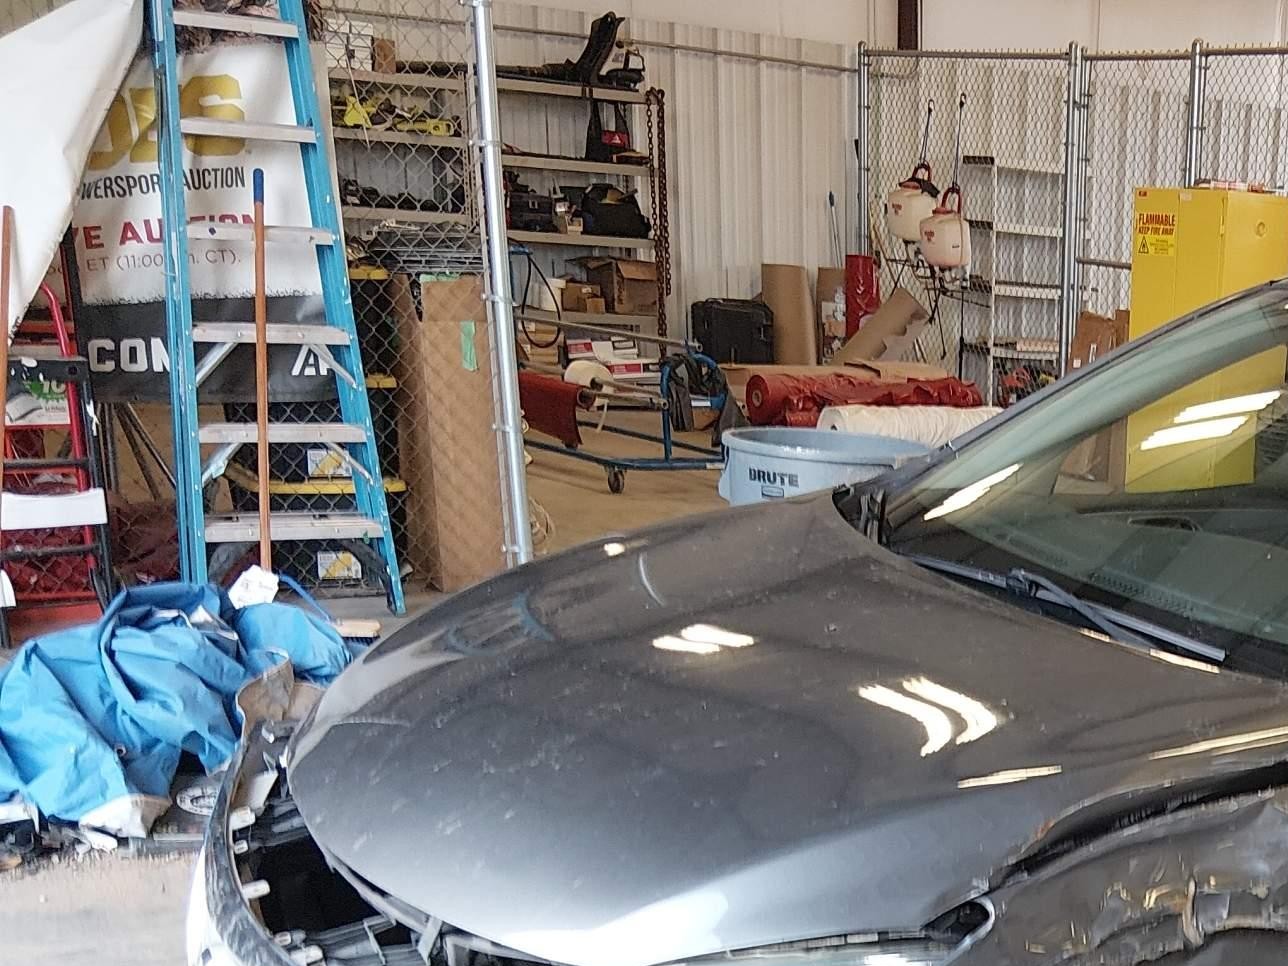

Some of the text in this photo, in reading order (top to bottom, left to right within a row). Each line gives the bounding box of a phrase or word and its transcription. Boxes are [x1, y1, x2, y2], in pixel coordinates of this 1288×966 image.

[183, 165, 246, 193] AUCTION
[1138, 213, 1176, 227] FLAMMABLE
[86, 257, 110, 272] ET
[116, 253, 164, 272] (11:00
[748, 467, 800, 489] BRUTE
